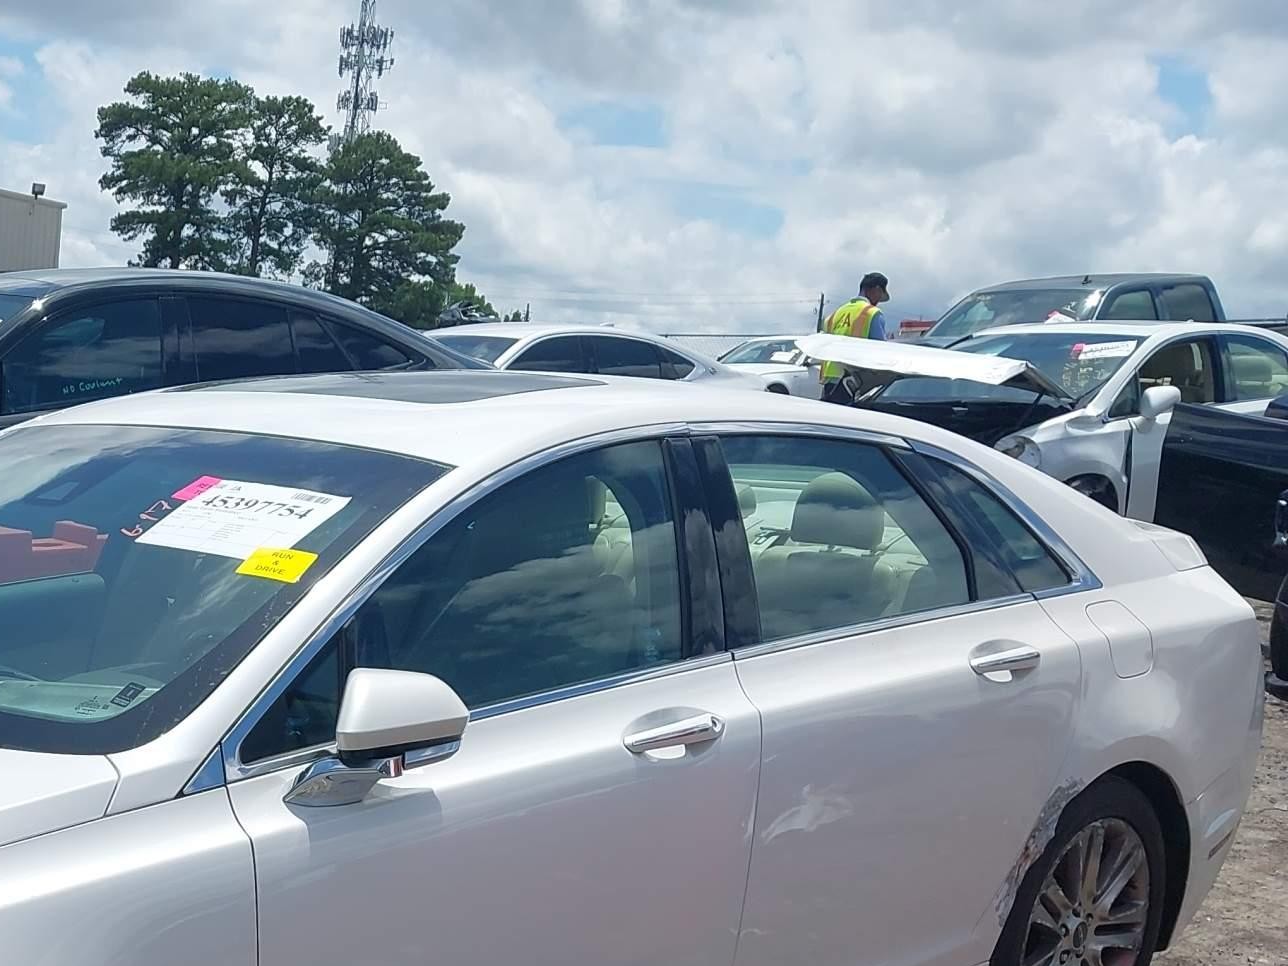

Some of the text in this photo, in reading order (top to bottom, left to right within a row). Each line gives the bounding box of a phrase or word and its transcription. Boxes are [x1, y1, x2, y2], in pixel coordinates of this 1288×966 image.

[202, 494, 313, 519] 45397754
[272, 551, 294, 560] RUN
[254, 564, 287, 576] DRIVE
